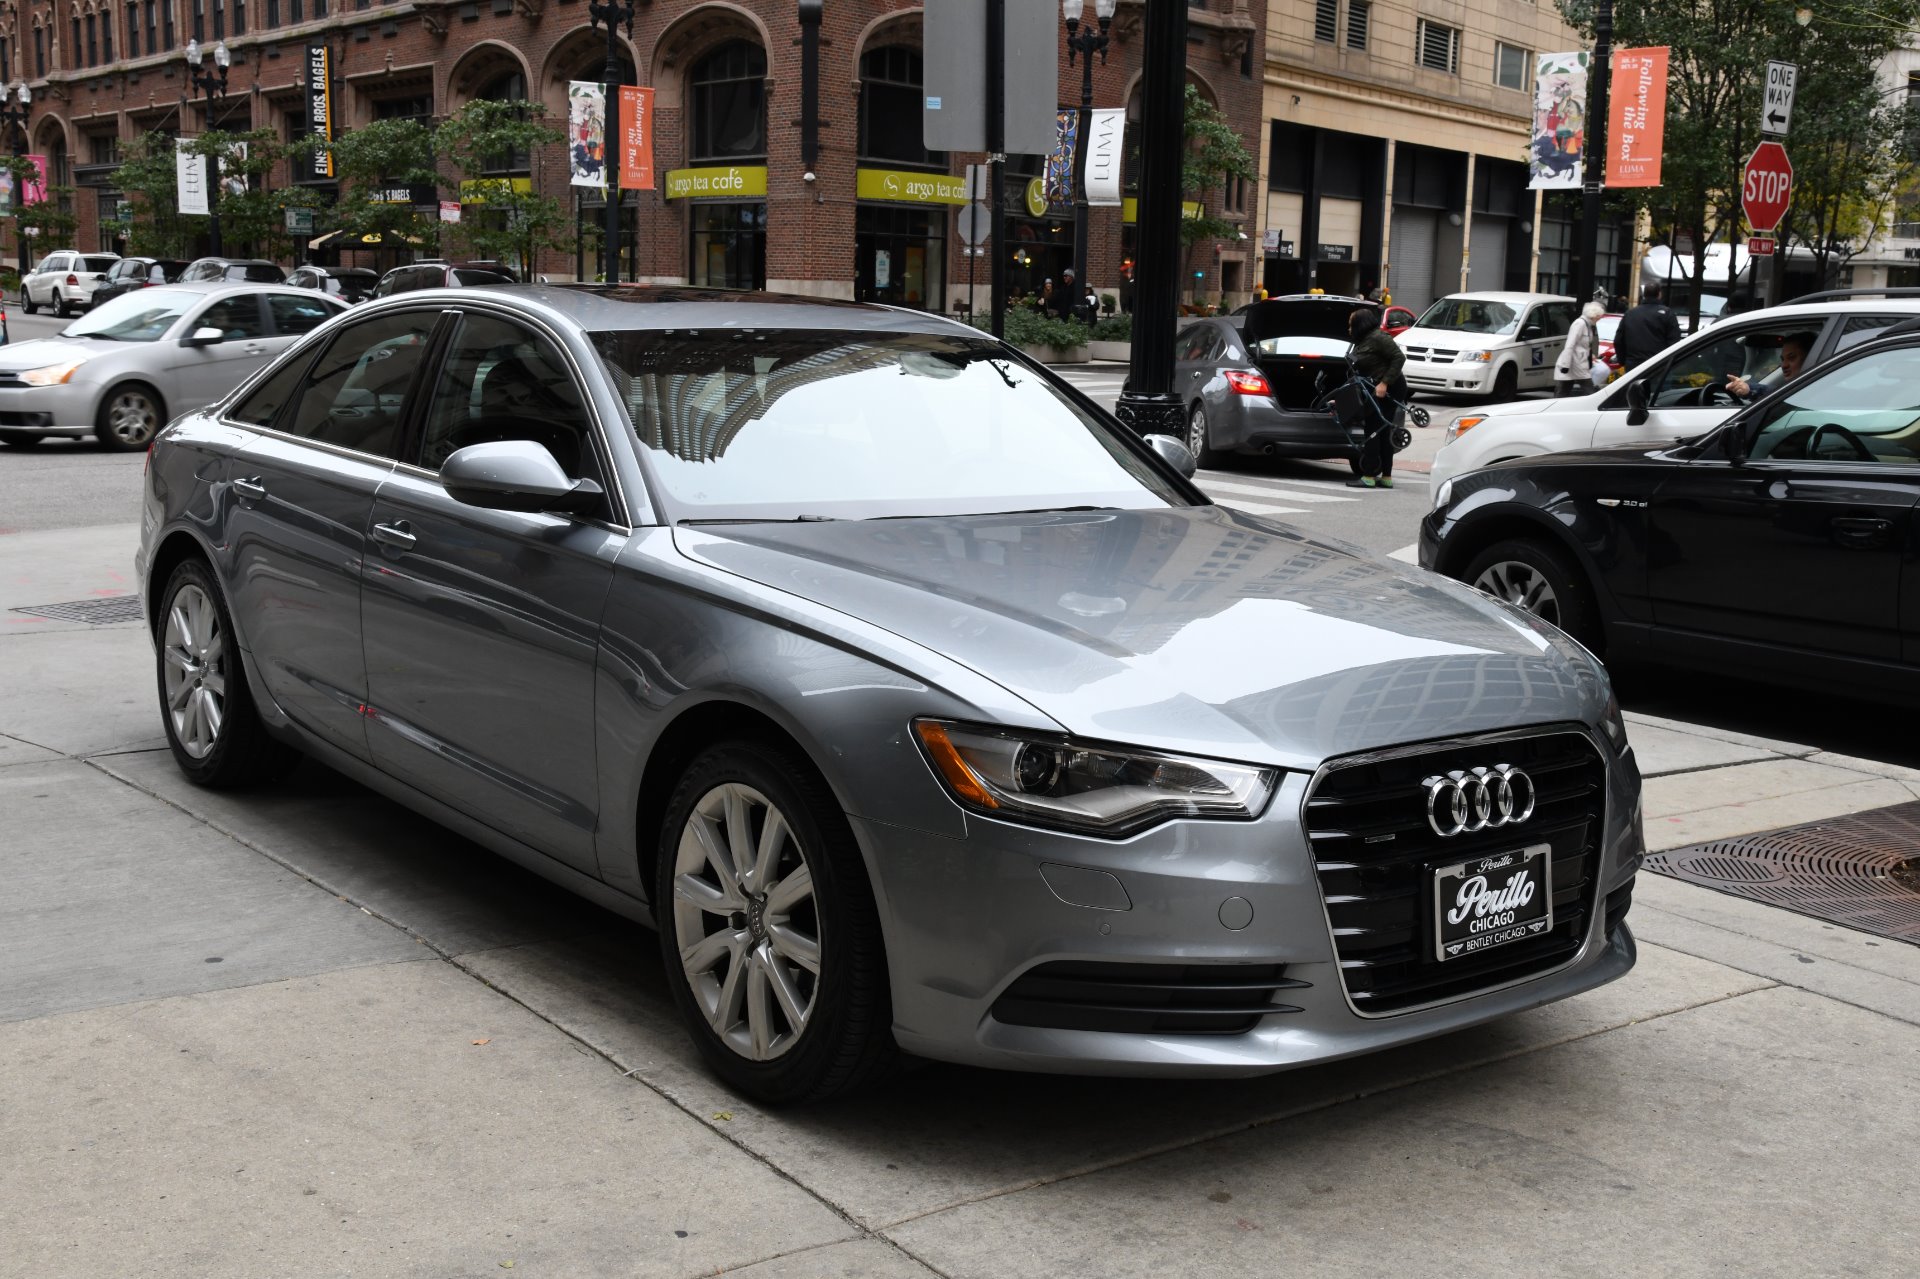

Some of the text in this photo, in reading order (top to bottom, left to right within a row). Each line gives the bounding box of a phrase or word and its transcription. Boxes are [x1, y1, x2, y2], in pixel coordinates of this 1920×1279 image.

[311, 48, 326, 90] BAGELS
[1771, 67, 1793, 87] ONE
[1634, 57, 1653, 129] Following
[1768, 87, 1791, 106] WAY
[313, 93, 327, 122] BROS.
[635, 93, 645, 146] Following
[1623, 106, 1636, 129] the
[628, 128, 637, 168] the Box
[1094, 116, 1115, 180] LUMA
[1621, 133, 1634, 161] Box
[185, 155, 199, 194] LUM
[675, 168, 743, 195] argo tea café
[1619, 165, 1645, 174] LUMA
[391, 189, 410, 201] BAGELS
[906, 181, 934, 200] argo
[937, 181, 950, 197] tea
[1746, 169, 1789, 204] STOP
[1750, 243, 1772, 252] ALL WAY
[1477, 855, 1513, 873] Perillo
[1448, 870, 1535, 925] Perillo
[1469, 910, 1515, 933] CHICAGO
[1466, 926, 1526, 951] BENTLEY CHICAGO
